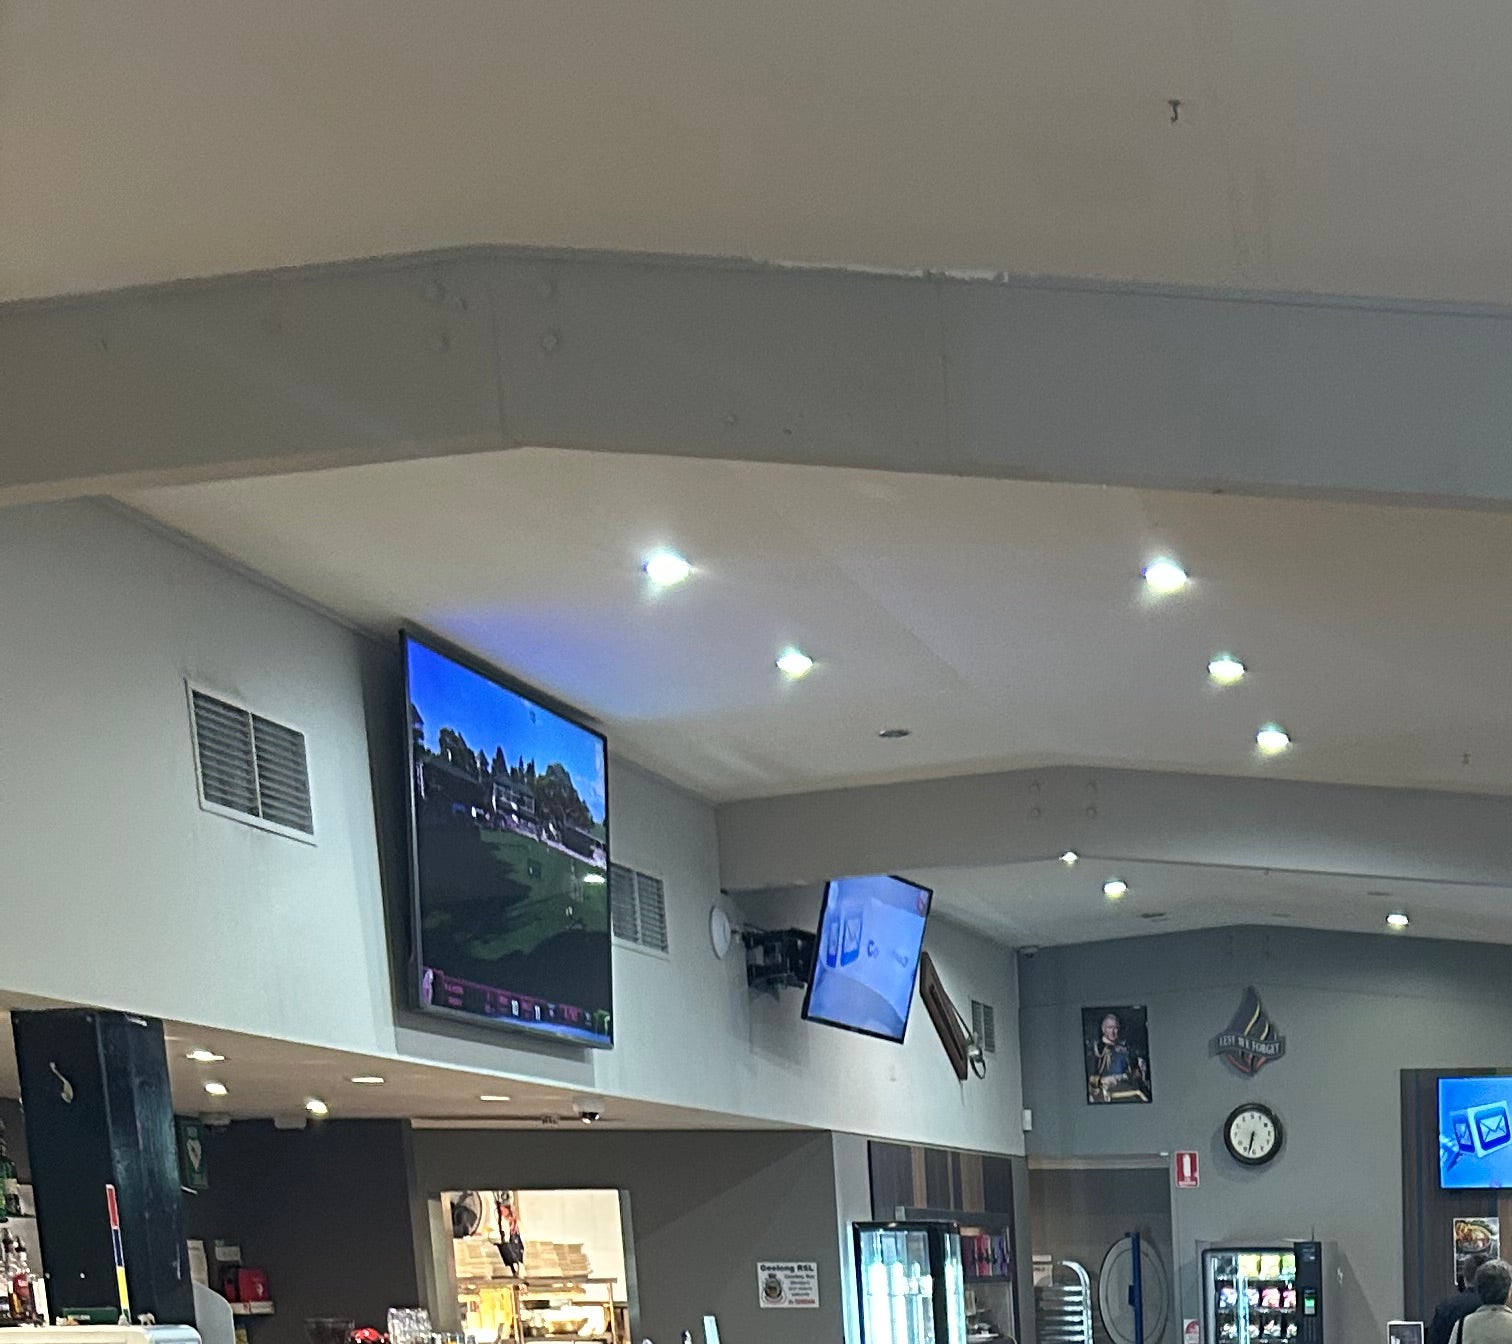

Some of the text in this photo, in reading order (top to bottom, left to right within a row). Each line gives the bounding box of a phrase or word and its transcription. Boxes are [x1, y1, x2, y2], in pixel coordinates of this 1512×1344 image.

[1219, 1035, 1281, 1055] LEST WE FORGET
[760, 1264, 814, 1273] Geelong RSL
